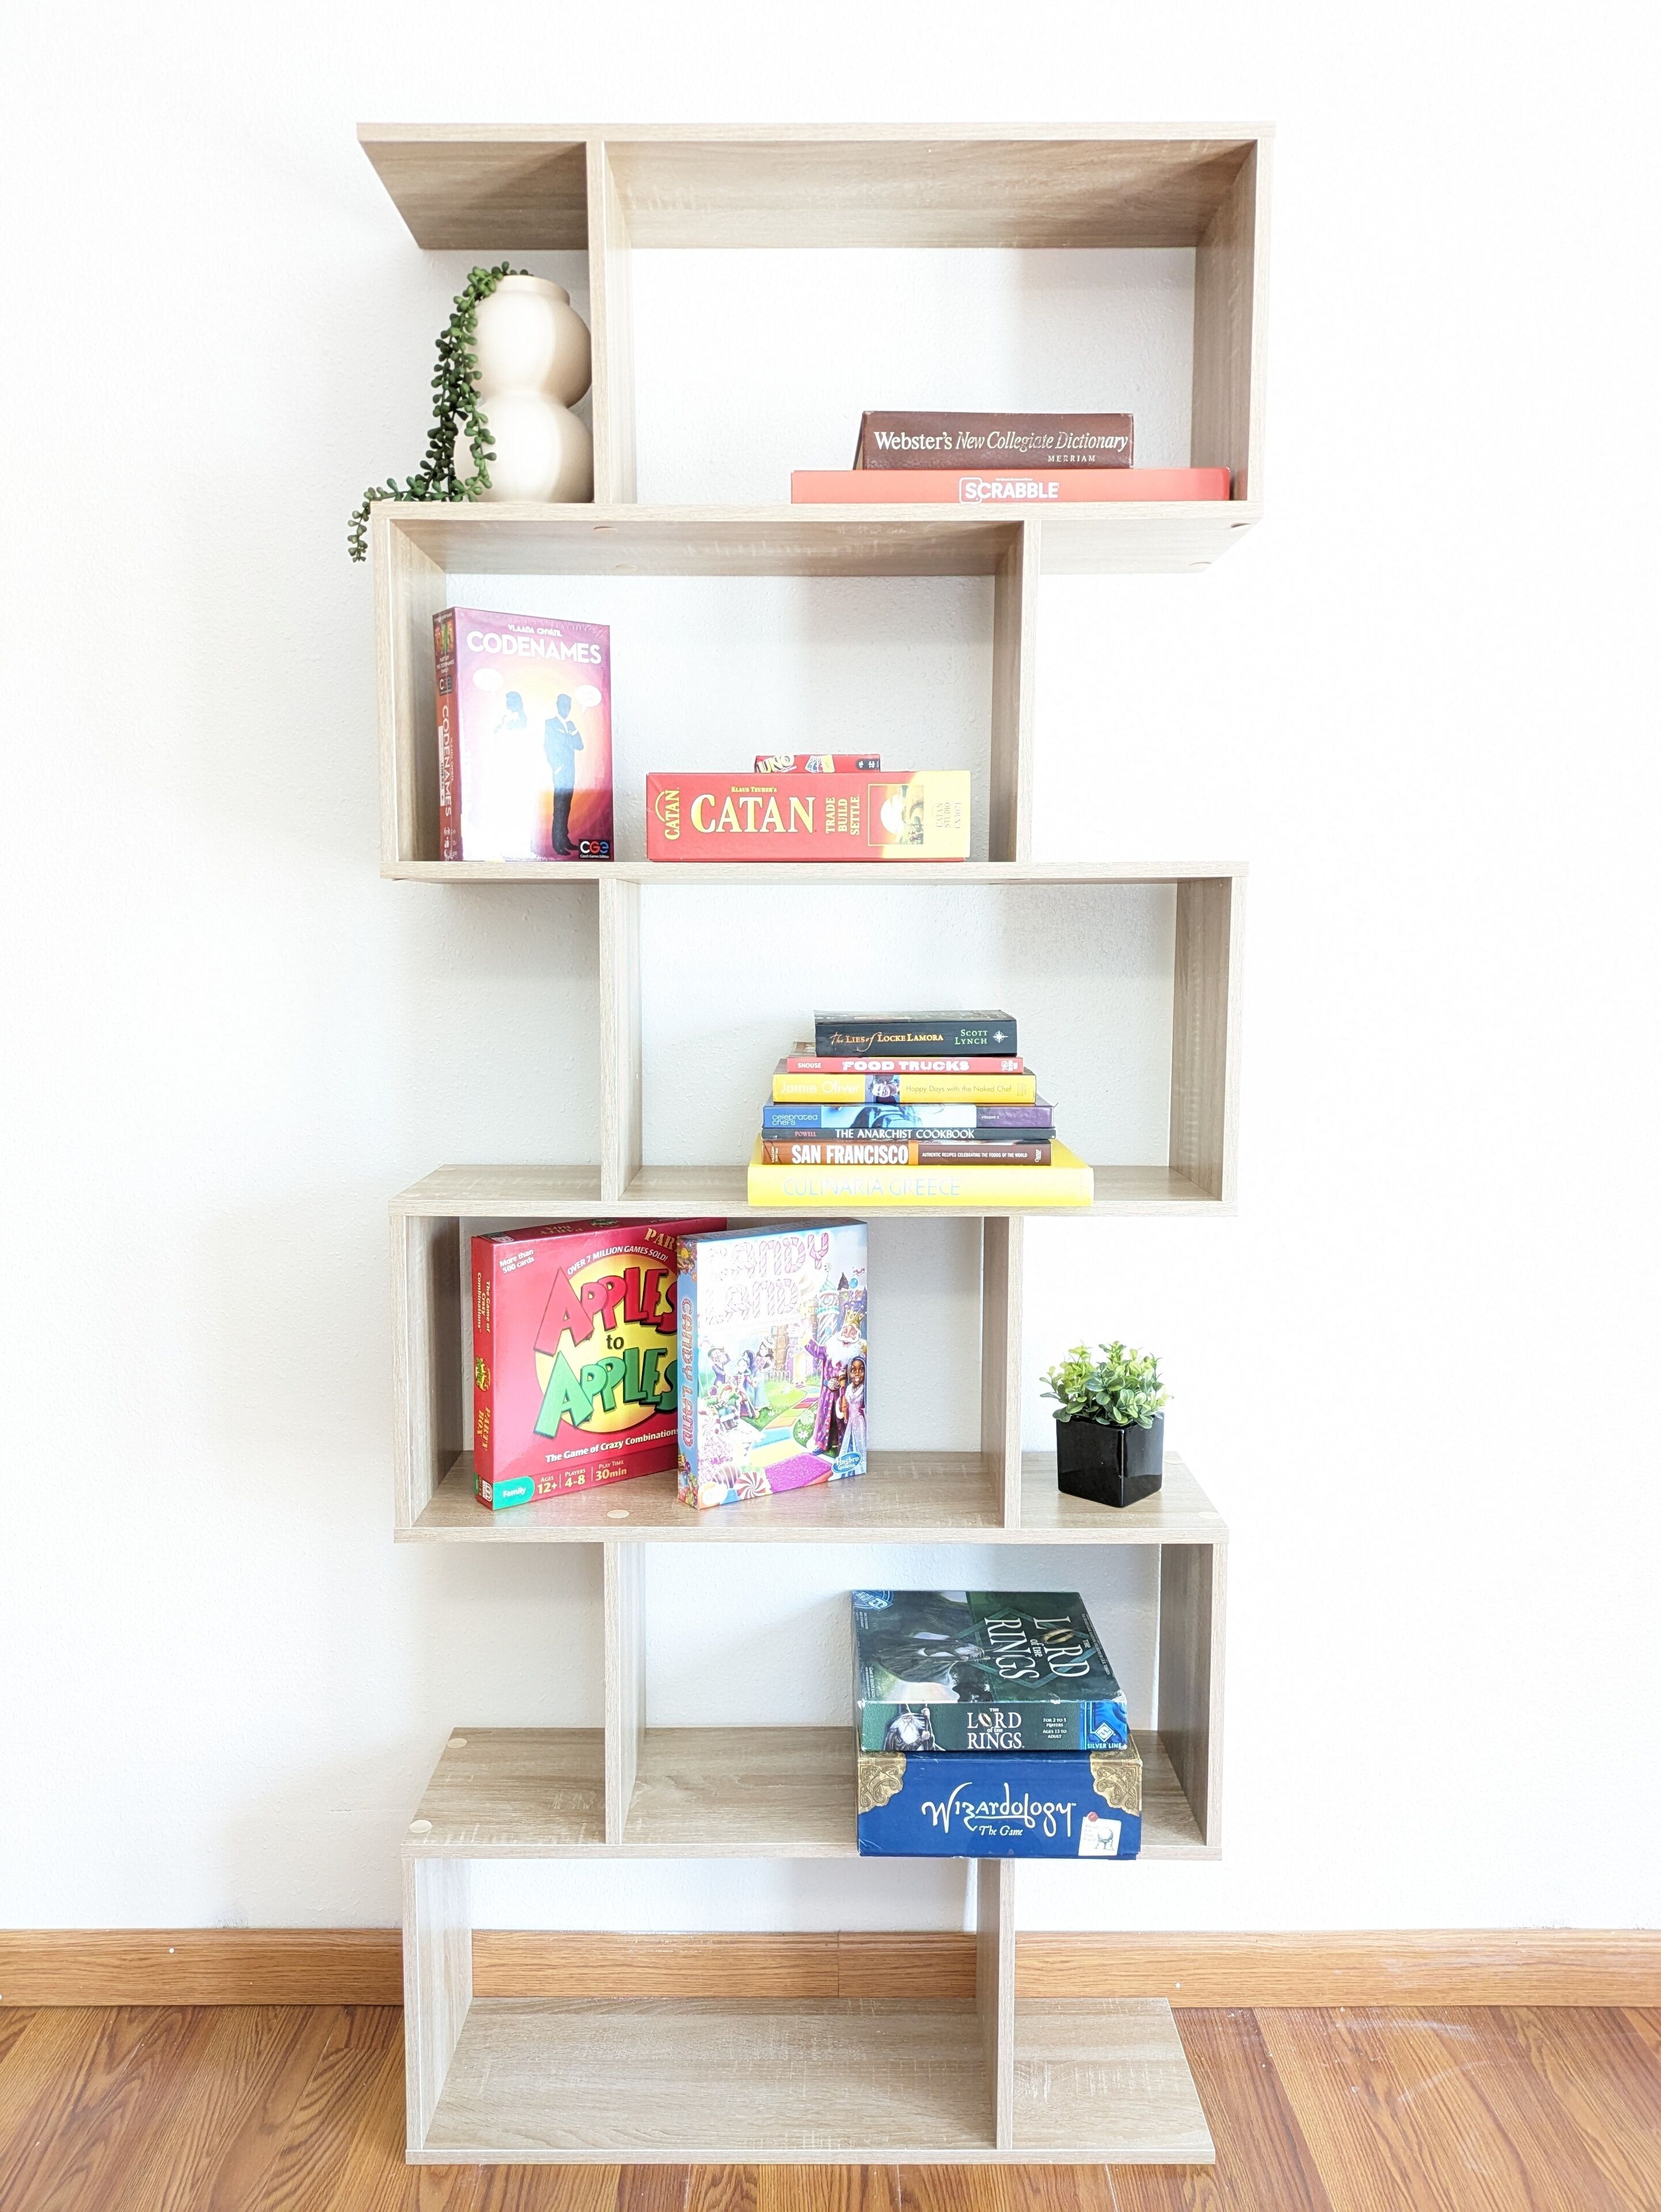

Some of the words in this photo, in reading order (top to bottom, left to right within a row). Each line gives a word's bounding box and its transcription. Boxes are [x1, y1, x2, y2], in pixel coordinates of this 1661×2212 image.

[873, 431, 952, 450] Webster's
[955, 431, 985, 449] New
[986, 431, 1054, 453] Collegiate
[1054, 431, 1129, 452] Dictionary
[964, 482, 1060, 499] SCRABBLE
[508, 624, 535, 634] VLAADA
[466, 631, 601, 665] CODENAMES
[442, 705, 452, 817] CODENAMES
[757, 754, 794, 772] UNO
[664, 789, 680, 840] CATAN
[691, 794, 816, 834] CATAN
[826, 797, 835, 834] TRADE
[838, 798, 847, 832] BUILD
[850, 796, 860, 835] SETTLE
[877, 1033, 906, 1043] LOCKE
[907, 1033, 944, 1042] LAMORA
[955, 1037, 988, 1045] LYNCH
[843, 1060, 895, 1071] FOOD
[898, 1060, 970, 1071] TRUCKS
[781, 1081, 817, 1093] Jamie
[821, 1080, 860, 1093] Oliver
[906, 1085, 927, 1094] Happy
[929, 1085, 945, 1093] Days
[835, 1129, 854, 1138] THE
[857, 1129, 913, 1139] ANARCHIST
[916, 1129, 975, 1139] COOKBOOK
[792, 1144, 821, 1164] SAN
[827, 1144, 909, 1164] FRANCISCO
[784, 1179, 884, 1195] CULINARIA
[890, 1179, 960, 1195] GREECE
[644, 1228, 676, 1251] PAR
[500, 1256, 517, 1267] More
[518, 1249, 534, 1259] than
[502, 1264, 516, 1274] 500
[517, 1256, 535, 1267] cards
[567, 1259, 586, 1275] OVER
[587, 1255, 592, 1263] 7
[593, 1246, 623, 1260] MILLION
[624, 1245, 648, 1254] GAMES
[648, 1249, 668, 1262] SOLD!
[708, 1232, 829, 1282] CANDY
[706, 1278, 799, 1325] LAND
[534, 1267, 678, 1357] APPLES
[486, 1323, 490, 1333] of
[606, 1334, 625, 1350] to
[682, 1298, 693, 1382] CANDY
[534, 1347, 678, 1438] APPLES
[682, 1385, 693, 1448] LAND
[482, 1406, 490, 1448] PARTY
[545, 1453, 562, 1463] The
[563, 1448, 588, 1460] Game
[590, 1444, 600, 1453] of
[600, 1440, 624, 1451] Crazy
[835, 1456, 859, 1466] Hasbro
[540, 1475, 554, 1483] AGES
[564, 1475, 586, 1488] 4-8
[565, 1468, 586, 1477] PLAYERS
[595, 1467, 627, 1482] 30min
[502, 1486, 527, 1498] Family
[537, 1482, 558, 1495] 12+
[984, 1618, 1039, 1679] RINGS
[1030, 1639, 1045, 1647] of
[1032, 1646, 1043, 1657] the
[1034, 1616, 1090, 1677] LORD
[1083, 1639, 1091, 1648] THE
[967, 1710, 1022, 1728] LORD
[967, 1733, 1022, 1749] RINGS
[922, 1782, 1070, 1838] Wizardology
[979, 1825, 997, 1836] The
[1000, 1825, 1023, 1836] Game
